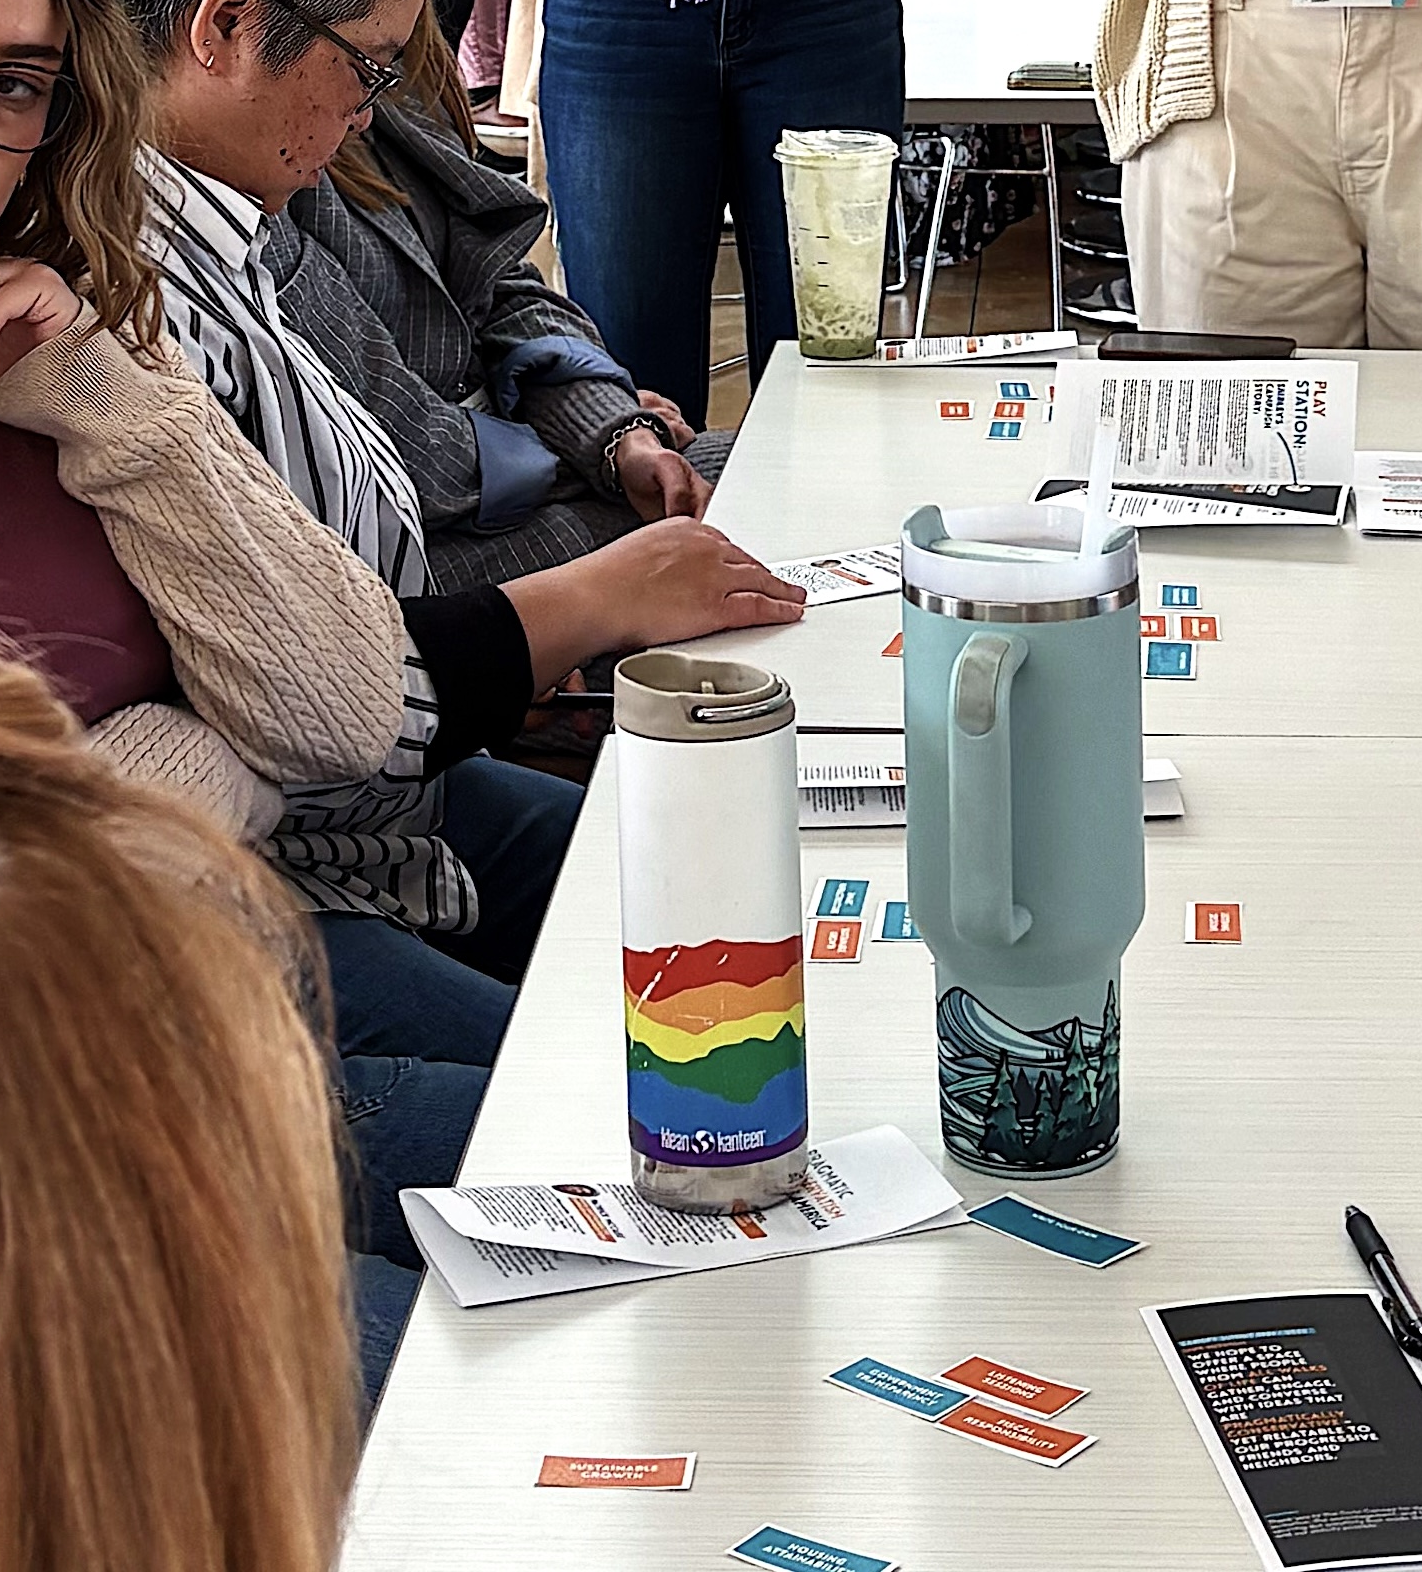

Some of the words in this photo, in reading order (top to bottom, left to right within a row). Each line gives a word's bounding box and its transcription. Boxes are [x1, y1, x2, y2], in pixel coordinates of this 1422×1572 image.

[1314, 381, 1328, 417] PLAY
[1293, 380, 1310, 449] STATION:
[661, 1127, 690, 1152] klean
[716, 1129, 767, 1154] kanteen
[1187, 1352, 1211, 1361] WE
[1215, 1347, 1256, 1357] HOPE
[1259, 1344, 1282, 1353] TO
[1192, 1356, 1239, 1369] OFFER
[1243, 1355, 1253, 1363] A
[1256, 1350, 1302, 1361] SPACE
[1195, 1363, 1247, 1376] WHERE
[1250, 1357, 1308, 1369] PEOPLE
[1199, 1372, 1244, 1384] FROM
[1248, 1369, 1274, 1378] ALL
[1277, 1364, 1328, 1374] WALKS
[856, 1372, 939, 1406] TRANSPARENCY
[868, 1368, 944, 1399] GOVERNMENT
[981, 1377, 1035, 1399] SESSIONS
[987, 1370, 1046, 1394] LISTENING
[1202, 1383, 1227, 1392] OF
[1229, 1378, 1256, 1388] LIFE
[1261, 1374, 1293, 1384] CAN
[1206, 1385, 1271, 1399] GATHER,
[1211, 1396, 1244, 1407] AND
[1248, 1387, 1328, 1402] CONVERSE
[1213, 1402, 1254, 1414] WITH
[1258, 1397, 1303, 1409] IDEAS
[1304, 1394, 1343, 1404] THAT
[997, 1419, 1035, 1436] FISCAL
[1219, 1412, 1249, 1423] ARE
[1221, 1410, 1345, 1430] PRAGMATICALLY
[963, 1416, 1058, 1449] RESPONSIBILITY
[1227, 1419, 1341, 1438] CONSERVATIVE
[1229, 1435, 1258, 1446] YET
[1262, 1426, 1346, 1441] RELATABLE
[1346, 1424, 1371, 1433] TO
[1234, 1443, 1271, 1454] OUR
[1273, 1433, 1380, 1449] PROGRESSIVE
[1238, 1448, 1303, 1463] FRIENDS
[1307, 1444, 1341, 1454] AND
[569, 1462, 658, 1473] SUSTAINABLE
[1242, 1454, 1339, 1471] NEIGHBORS.
[580, 1471, 644, 1480] GROWTH
[787, 1543, 847, 1565] HOUSING
